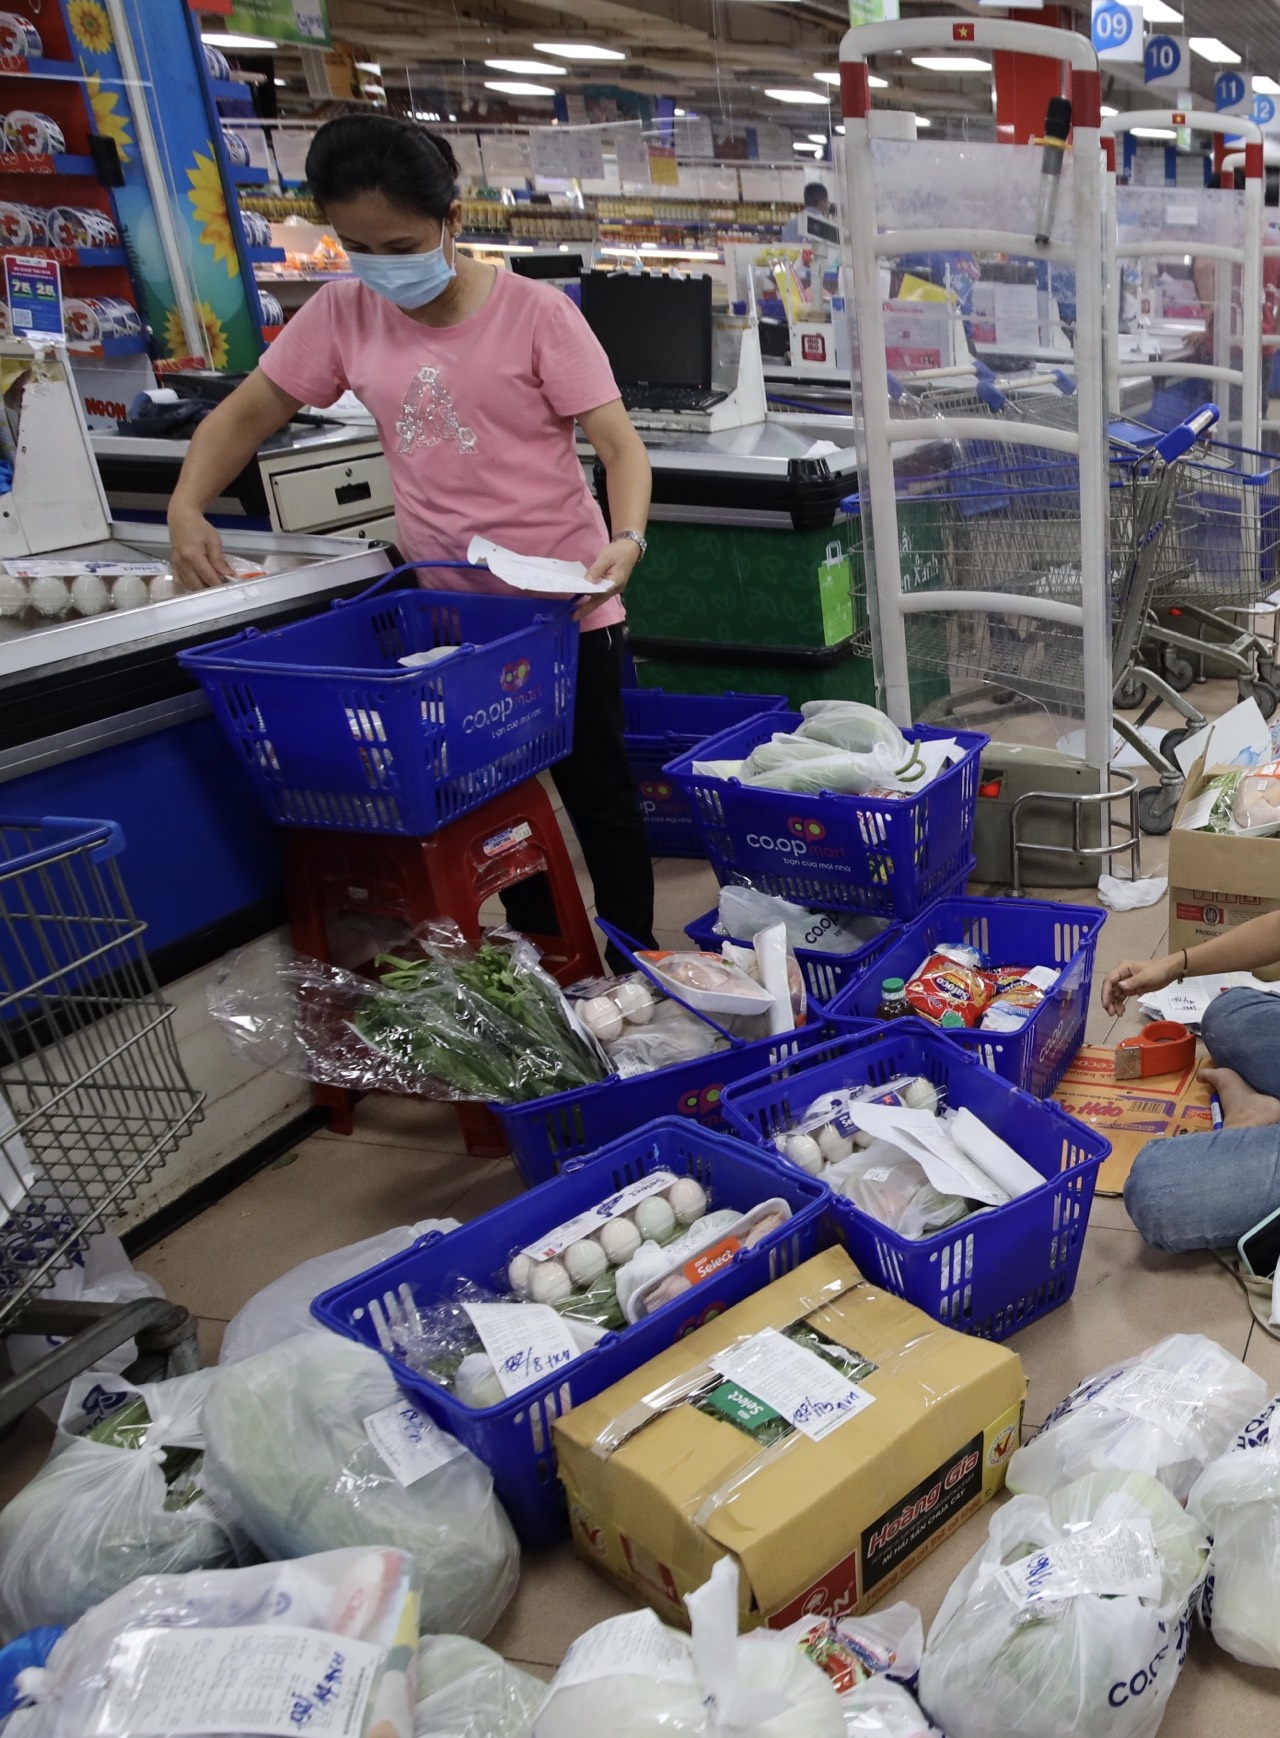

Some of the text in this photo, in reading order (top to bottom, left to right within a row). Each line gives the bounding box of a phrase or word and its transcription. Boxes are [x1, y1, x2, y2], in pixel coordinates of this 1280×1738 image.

[1097, 13, 1128, 37] 09
[1150, 47, 1174, 66] 10
[1219, 80, 1236, 99] 11
[1254, 101, 1270, 119] 12
[783, 857, 799, 866] bạn
[819, 861, 834, 873] mọi
[697, 1249, 735, 1279] Select
[727, 1390, 765, 1417] Select
[866, 1481, 943, 1559] Hoàng
[943, 1450, 979, 1490] Gia
[927, 1504, 949, 1525] CHUA
[950, 1487, 966, 1505] CAY
